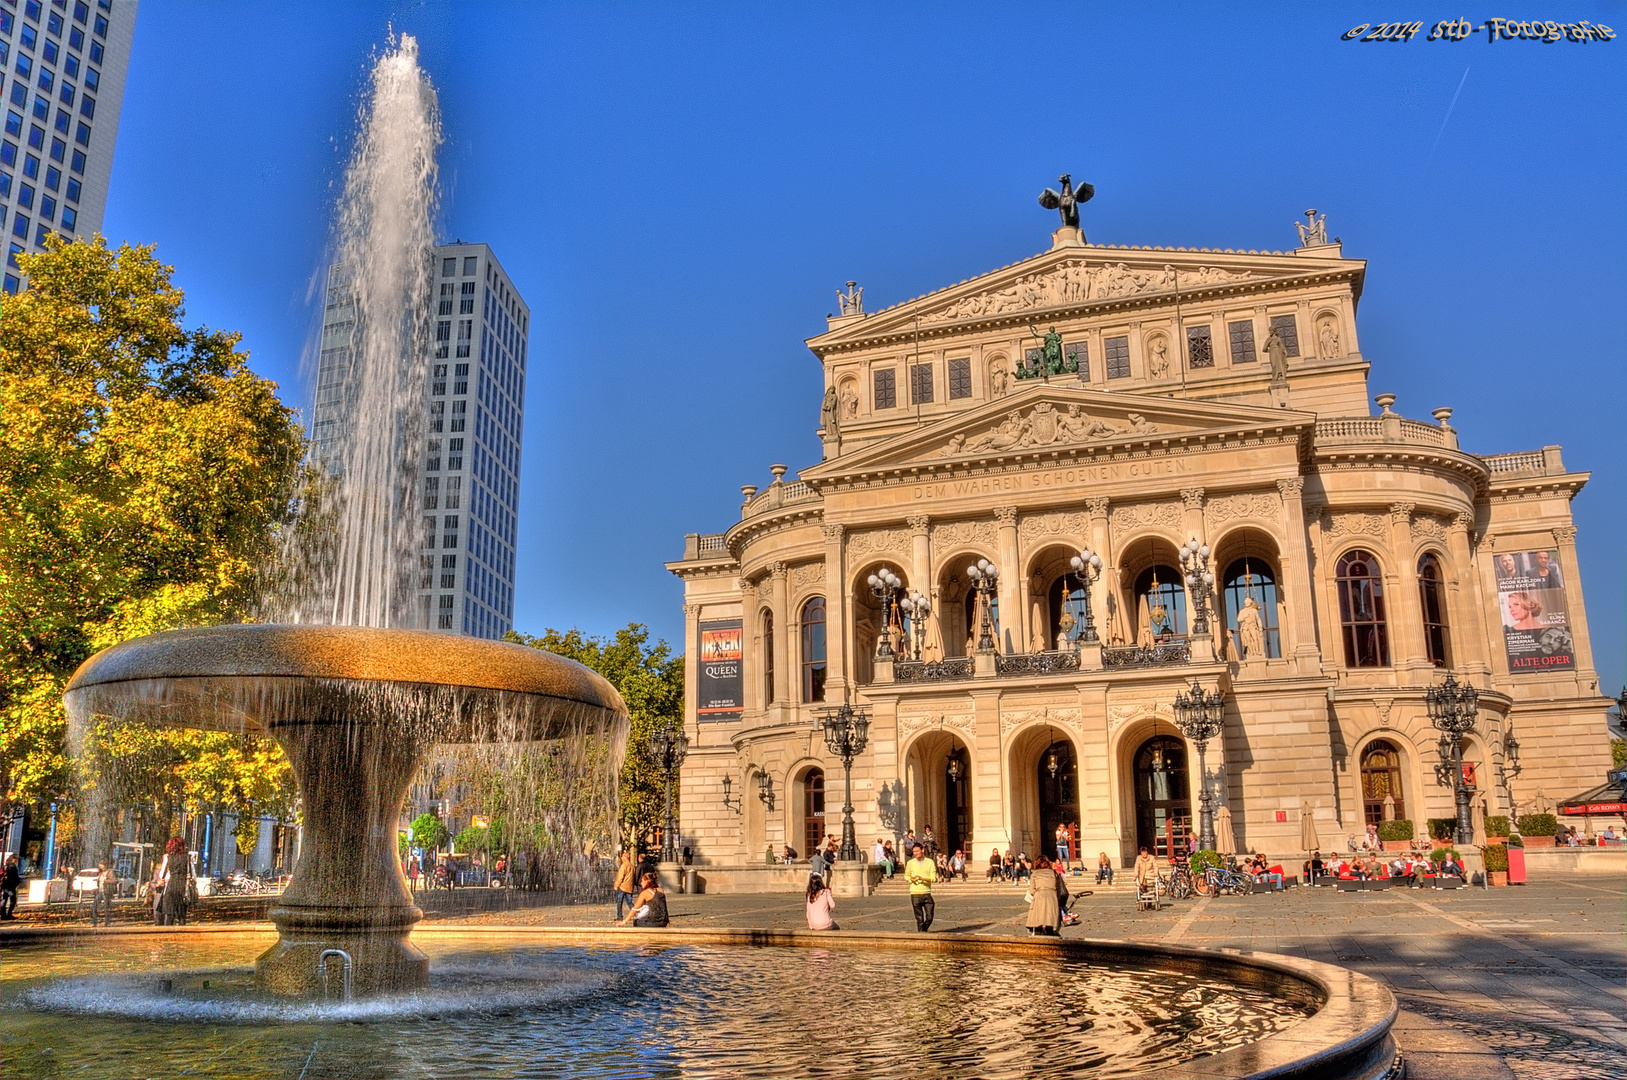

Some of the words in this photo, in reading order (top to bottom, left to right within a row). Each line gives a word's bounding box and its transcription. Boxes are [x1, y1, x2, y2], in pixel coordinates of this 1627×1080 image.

[914, 484, 946, 499] DEM
[953, 476, 1022, 495] WAHREN
[1031, 465, 1119, 487] SCHOENEN
[1129, 458, 1192, 477] GUTEN.
[1513, 657, 1540, 667] ALTE
[1541, 655, 1570, 666] OPER
[705, 666, 738, 679] QUEEN
